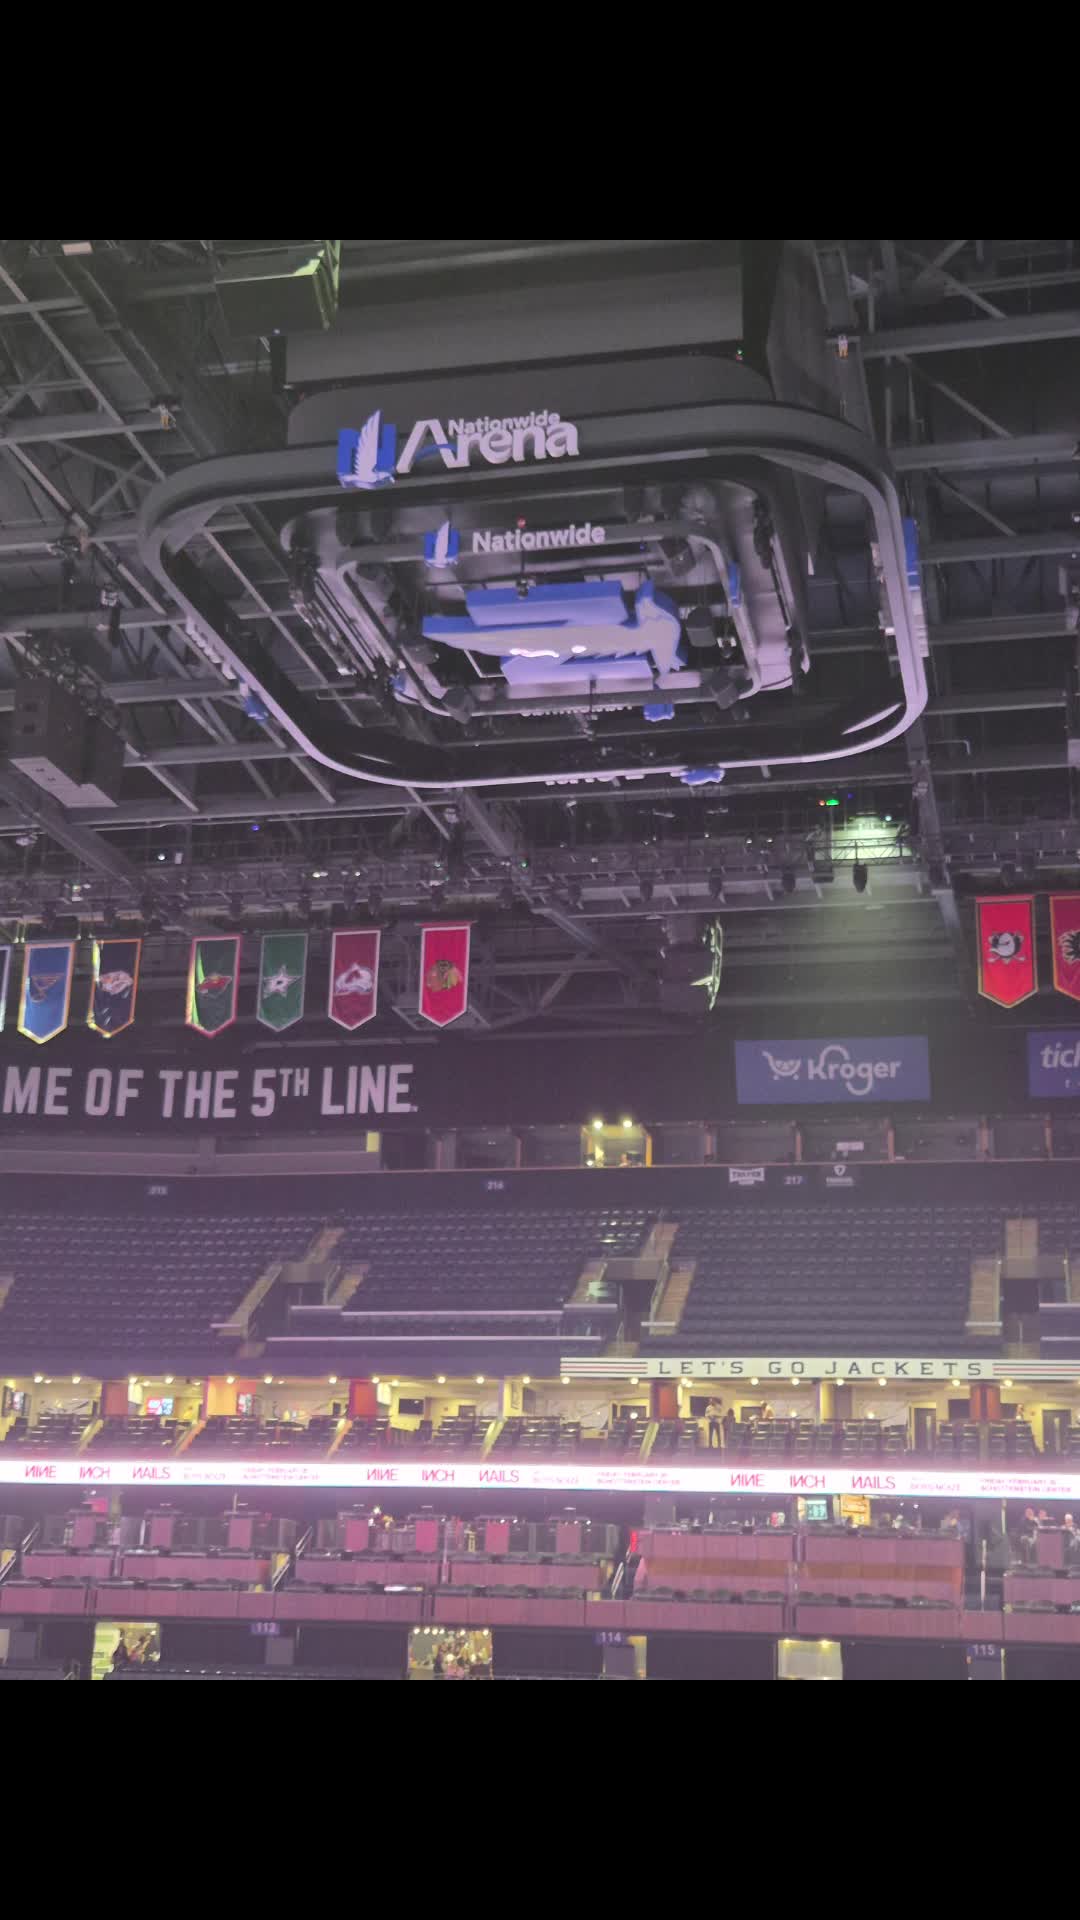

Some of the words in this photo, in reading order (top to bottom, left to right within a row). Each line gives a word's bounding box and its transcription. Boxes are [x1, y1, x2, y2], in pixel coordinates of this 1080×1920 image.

[448, 409, 561, 436] Nationwide
[396, 418, 580, 475] Arena
[472, 521, 607, 554] Nationwide
[807, 1044, 902, 1096] Kroger
[2, 1066, 73, 1116] ME
[84, 1068, 145, 1117] OF
[158, 1068, 240, 1119] THE
[250, 1067, 310, 1118] 5TH
[658, 1360, 745, 1376] LET'S
[767, 1360, 806, 1375] GO
[824, 1360, 983, 1377] JACKETS
[971, 1643, 996, 1656] 115
